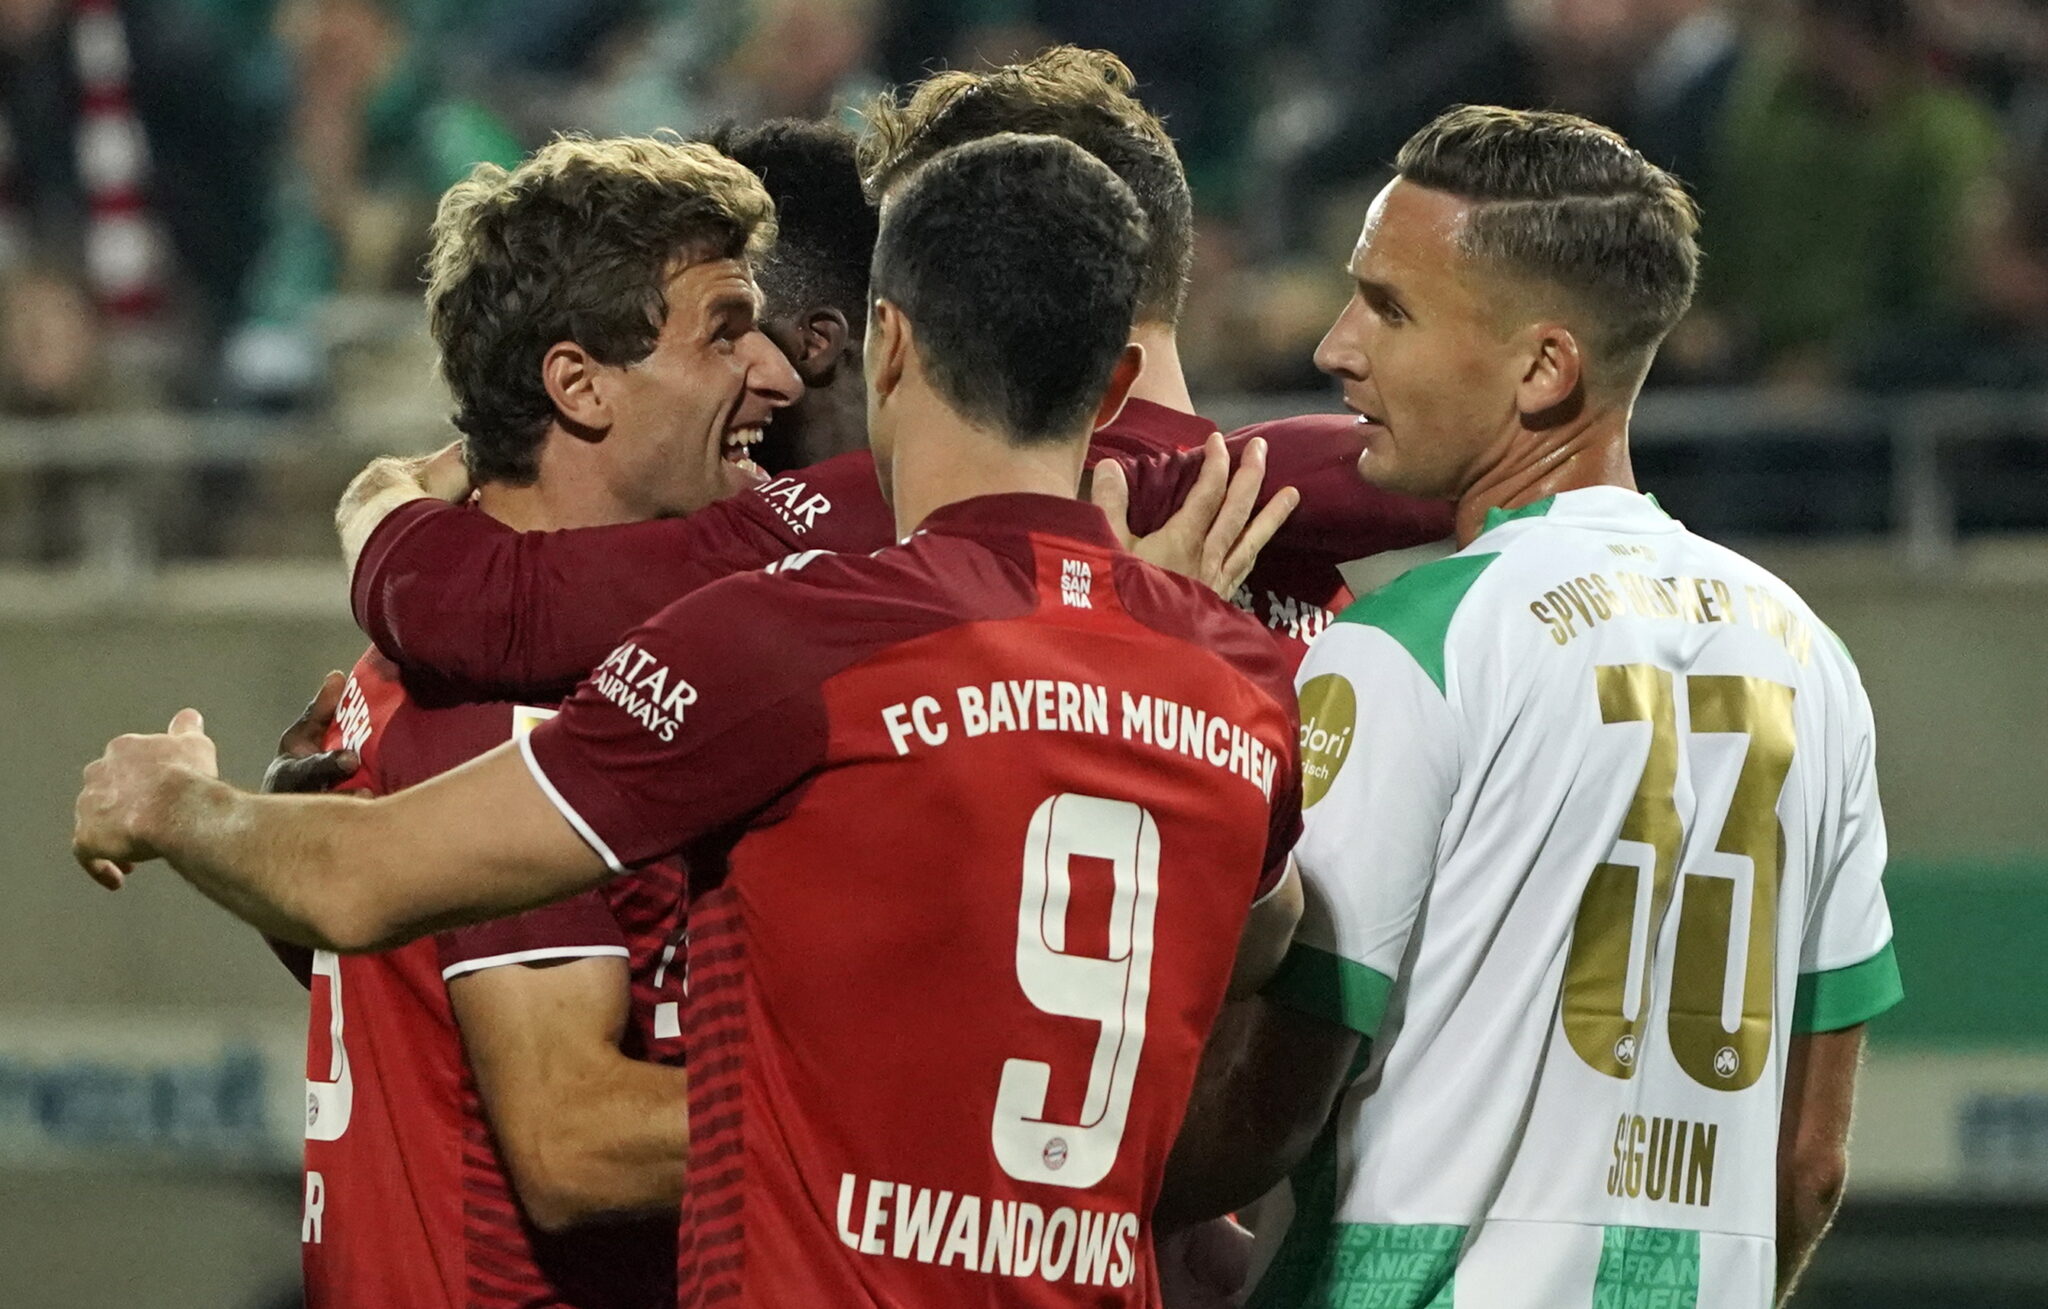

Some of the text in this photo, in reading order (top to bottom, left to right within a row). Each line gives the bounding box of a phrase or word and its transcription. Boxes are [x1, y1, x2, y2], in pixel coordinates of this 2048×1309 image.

[1060, 575, 1091, 595] SAN
[1062, 558, 1092, 578] MIA
[1062, 590, 1093, 609] MIA
[591, 670, 679, 742] AIRWAYS
[597, 641, 698, 723] ATAR
[880, 679, 1280, 804] FC BAYERN MÜNCHEN
[1562, 663, 1797, 1092] 33
[991, 792, 1161, 1189] 9
[836, 1172, 1140, 1289] LEWANDOWS
